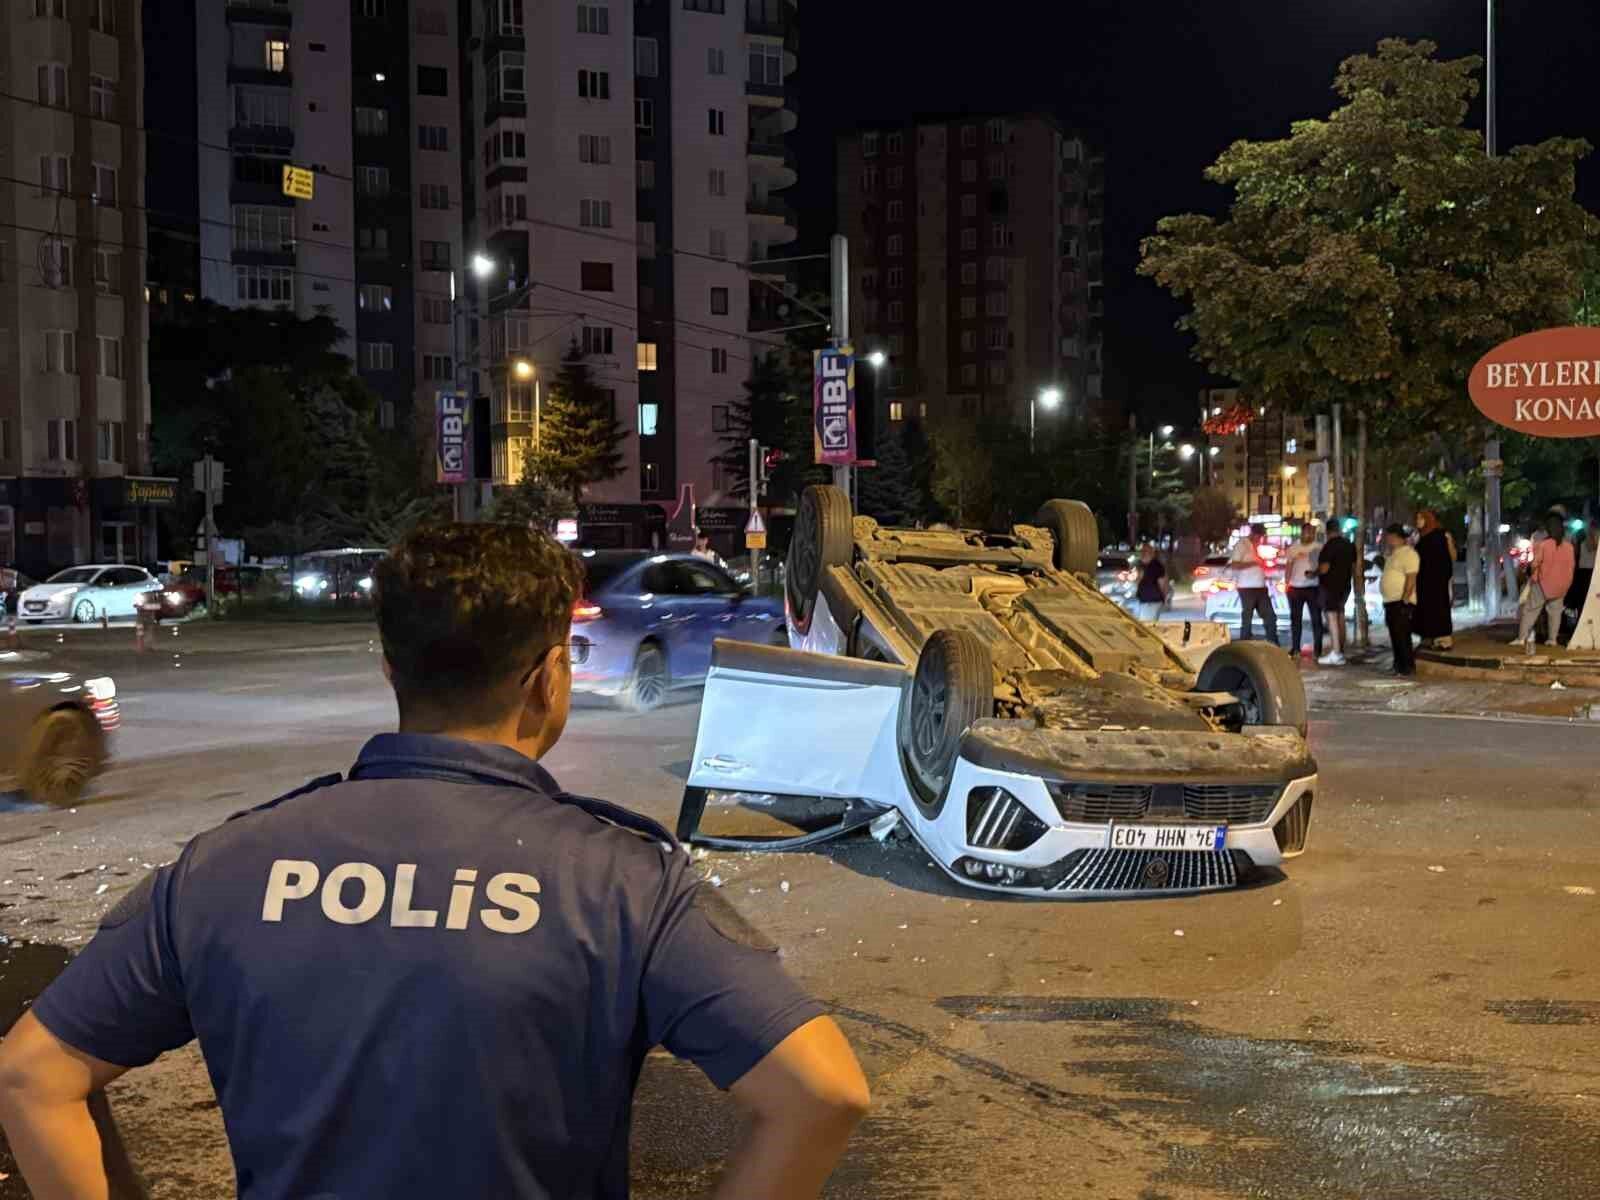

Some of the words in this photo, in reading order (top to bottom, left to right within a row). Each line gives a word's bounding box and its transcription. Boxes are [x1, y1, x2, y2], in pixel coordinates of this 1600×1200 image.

[1115, 828, 1147, 846] 403
[1155, 829, 1186, 846] NHH
[1196, 830, 1215, 847] 34
